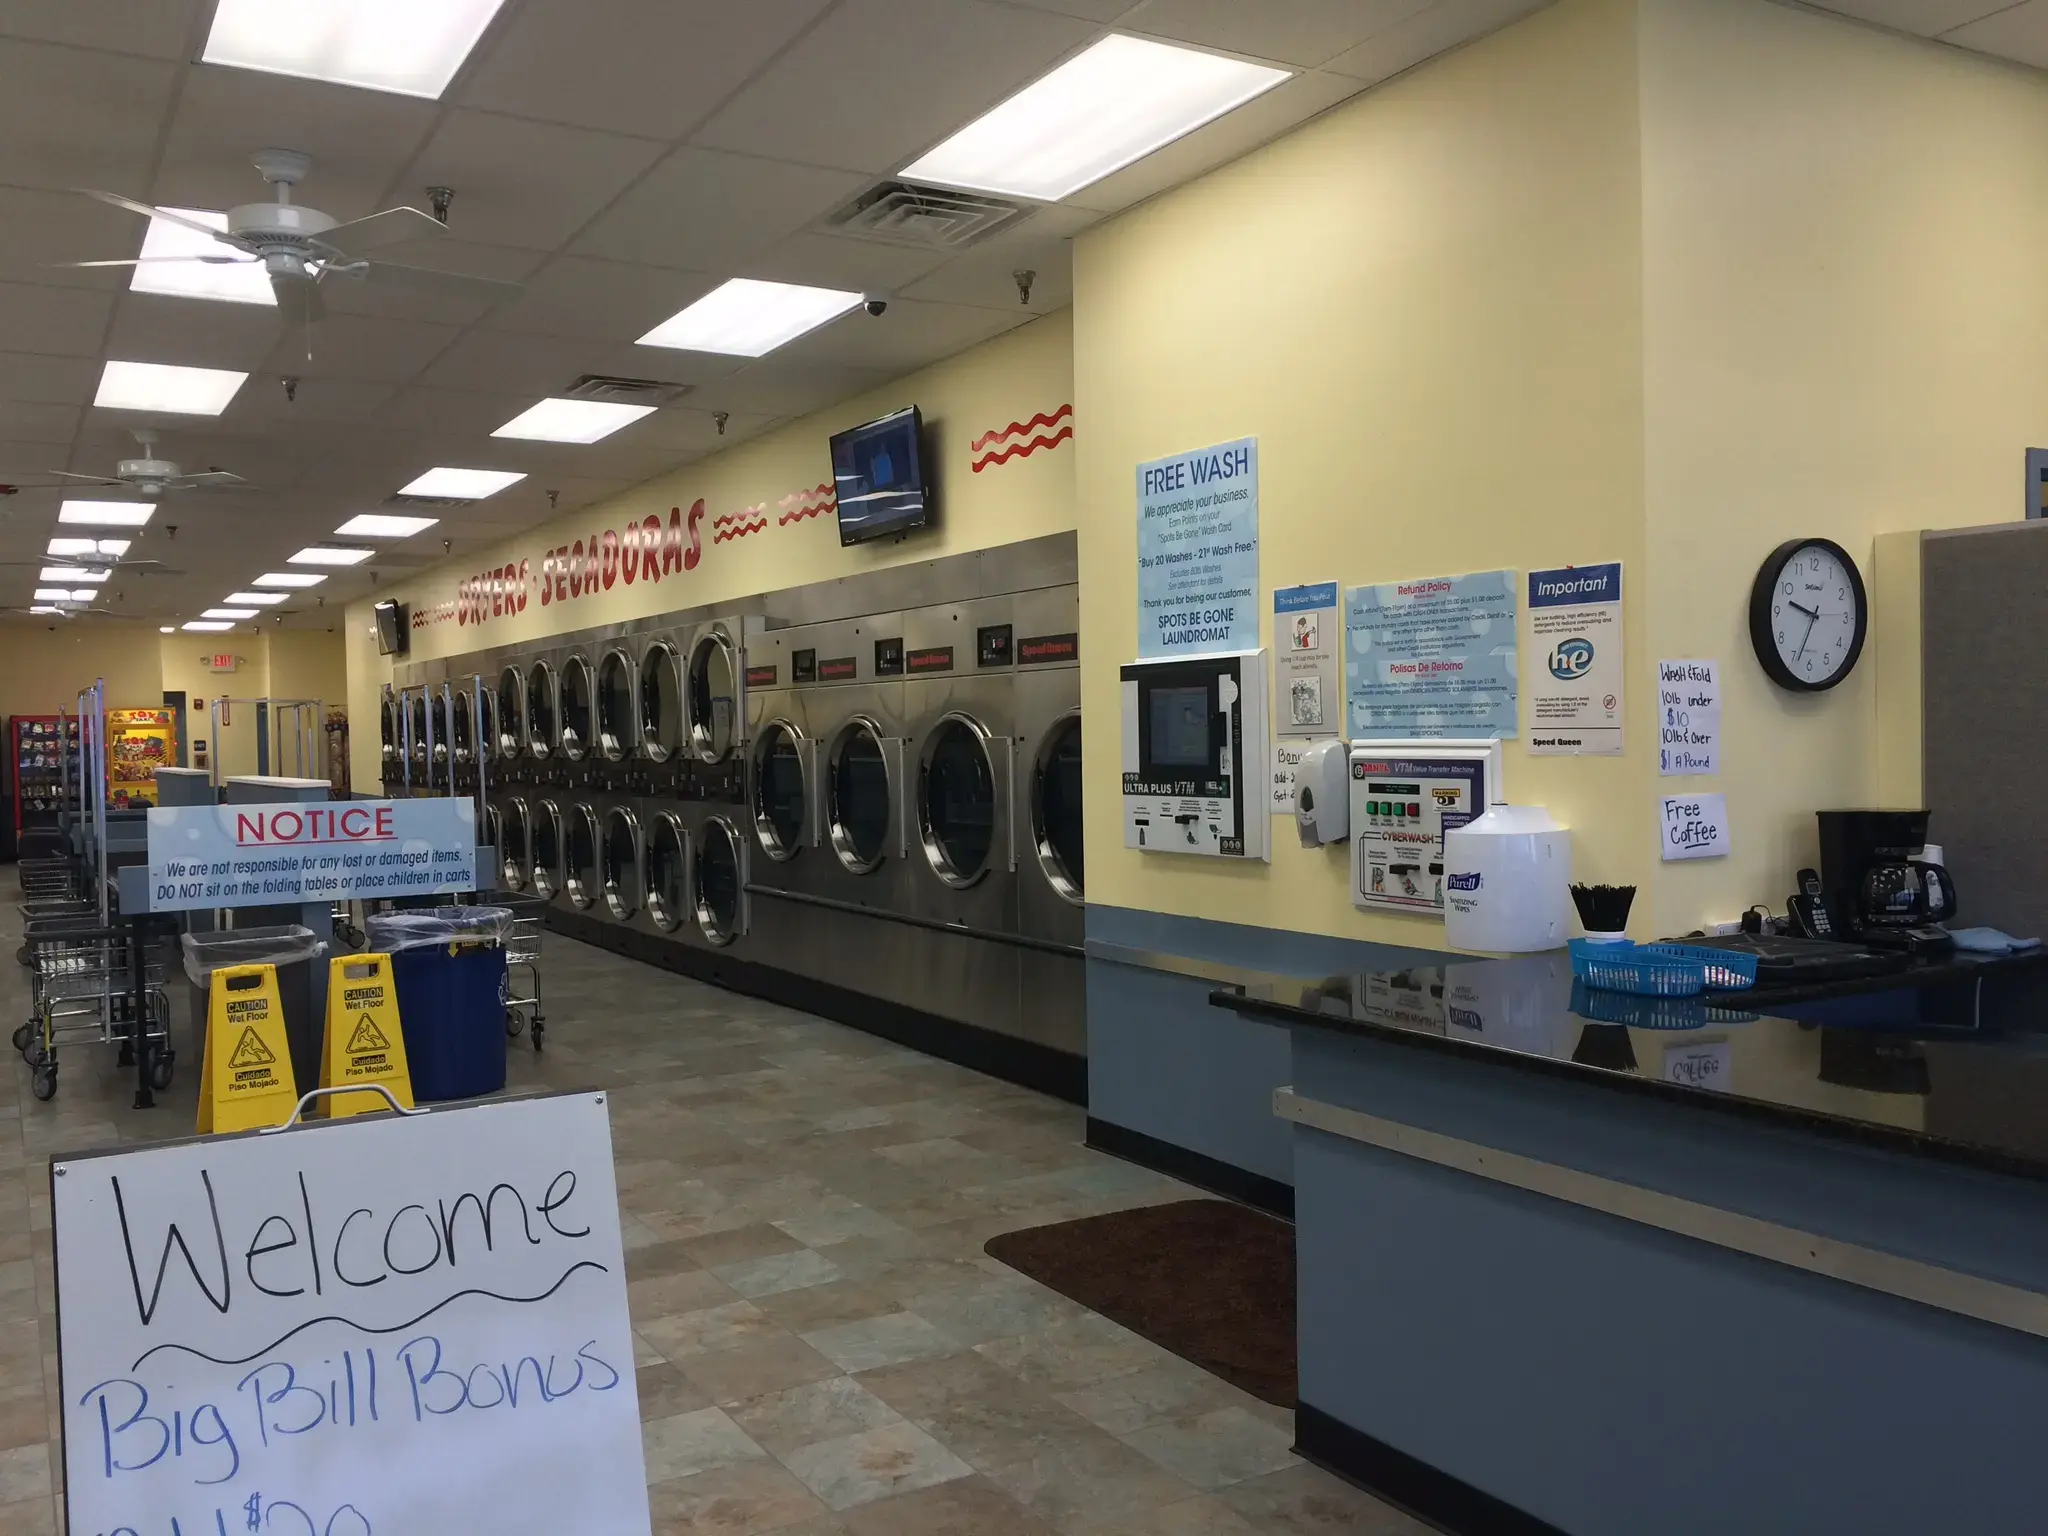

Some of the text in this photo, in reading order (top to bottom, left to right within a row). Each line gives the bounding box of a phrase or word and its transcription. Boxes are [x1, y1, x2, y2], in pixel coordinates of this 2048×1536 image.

[1145, 447, 1248, 496] FREE WASH
[1144, 489, 1249, 519] We appreciate your business.
[1169, 518, 1180, 527] Earn
[1182, 515, 1198, 525] Points
[1207, 510, 1220, 522] your
[1176, 531, 1183, 540] Be
[1201, 524, 1217, 536] Wash
[1219, 522, 1232, 532] Card
[458, 498, 705, 627] DRYERS SECADURAS
[1141, 558, 1153, 568] Buy
[1156, 555, 1164, 566] 20
[1165, 552, 1192, 564] Washes
[1212, 545, 1233, 556] Wash
[1170, 569, 1189, 578] Excludes
[1203, 564, 1221, 573] Washes
[1795, 563, 1803, 576] 11
[1810, 558, 1819, 571] 12
[1829, 567, 1832, 579] 1
[1168, 582, 1177, 591] See
[1177, 579, 1200, 589] attendant
[1208, 576, 1223, 585] details
[1398, 581, 1451, 595] Refund Policy
[1538, 575, 1607, 598] Important
[1781, 582, 1794, 595] 10
[1144, 598, 1161, 608] Thank
[1163, 599, 1174, 607] you
[1176, 596, 1184, 605] for
[1186, 593, 1204, 604] being
[1206, 592, 1217, 601] our
[1280, 595, 1293, 606] Think
[1294, 594, 1309, 603] Before
[1309, 594, 1319, 602] You
[1838, 588, 1845, 601] 2
[1774, 605, 1780, 618] 9
[1843, 612, 1849, 624] 3
[1158, 608, 1234, 629] SPOTS BE GONE
[1162, 626, 1230, 645] LAUNDROMAT
[1778, 631, 1784, 644] 8
[1836, 637, 1842, 648] 4
[1022, 643, 1046, 658] Speed
[1791, 651, 1797, 663] 7
[214, 655, 232, 666] EXIT
[1552, 644, 1589, 673] he
[1806, 659, 1813, 671] 6
[1823, 653, 1830, 665] 5
[1390, 661, 1463, 673] Polisas De Retorno
[1662, 690, 1713, 707] 10lb under
[129, 711, 156, 719] TOY
[1667, 708, 1689, 727] $10
[1533, 738, 1555, 747] Speed
[1691, 731, 1712, 745] Over
[1660, 749, 1710, 770] $1 A Pound
[1394, 763, 1413, 772] VTM
[1451, 766, 1475, 774] Machine
[1124, 783, 1149, 793] ULTRA
[1151, 784, 1171, 793] PLUS
[1175, 781, 1196, 795] VTM
[1665, 800, 1700, 821] Free
[237, 807, 393, 843] NOTICE
[1382, 831, 1434, 844] CYBERWASH
[1670, 821, 1717, 845] Coffee
[166, 848, 462, 878] We are not responsible for any lost or damaged items.
[157, 869, 470, 900] DO NOT sit on the folding tables or place children in carts
[1450, 896, 1478, 906] SANITIZING
[1454, 904, 1470, 913] WIPES
[345, 987, 382, 999] CAUTION
[227, 1000, 267, 1012] CAUTION
[345, 999, 384, 1010] Wet Floor
[227, 1011, 268, 1023] Wet Floor
[352, 1055, 386, 1066] Cuidado
[236, 1069, 271, 1081] Cuidado
[345, 1063, 393, 1076] Piso Mojado
[228, 1078, 279, 1092] Piso Mojado
[110, 1169, 592, 1326] Welcome
[78, 1336, 620, 1486] Big Bill Bonus
